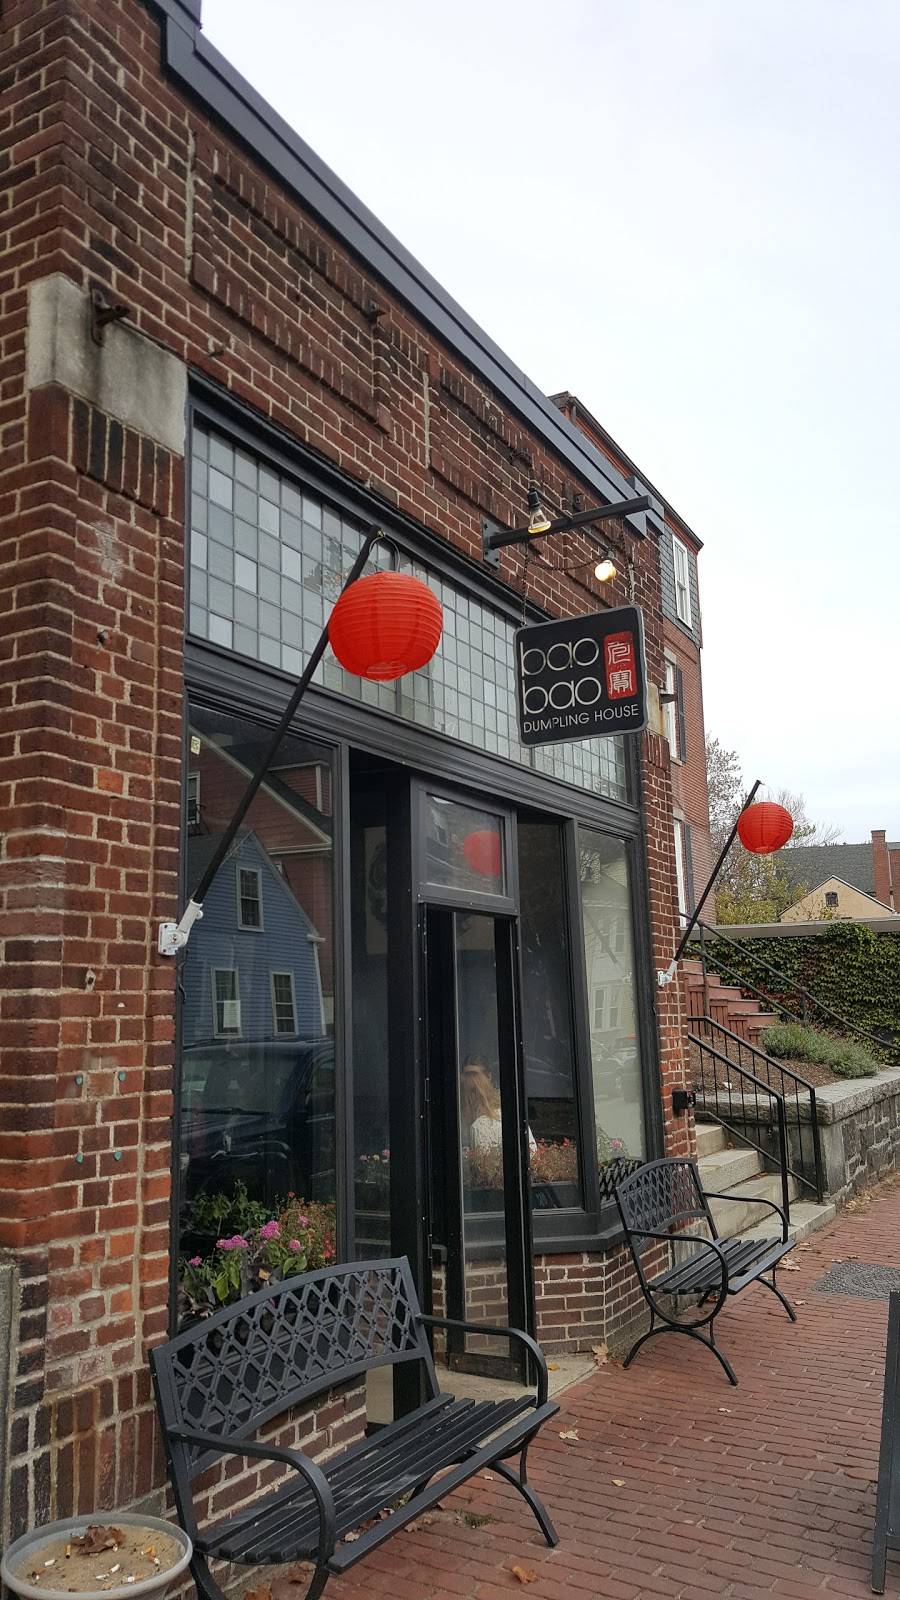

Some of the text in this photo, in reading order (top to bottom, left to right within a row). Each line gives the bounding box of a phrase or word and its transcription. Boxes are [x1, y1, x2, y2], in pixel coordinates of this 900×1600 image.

[520, 638, 599, 677] bao
[522, 677, 601, 715] bao
[523, 704, 639, 733] DUMPLING HOUSE
